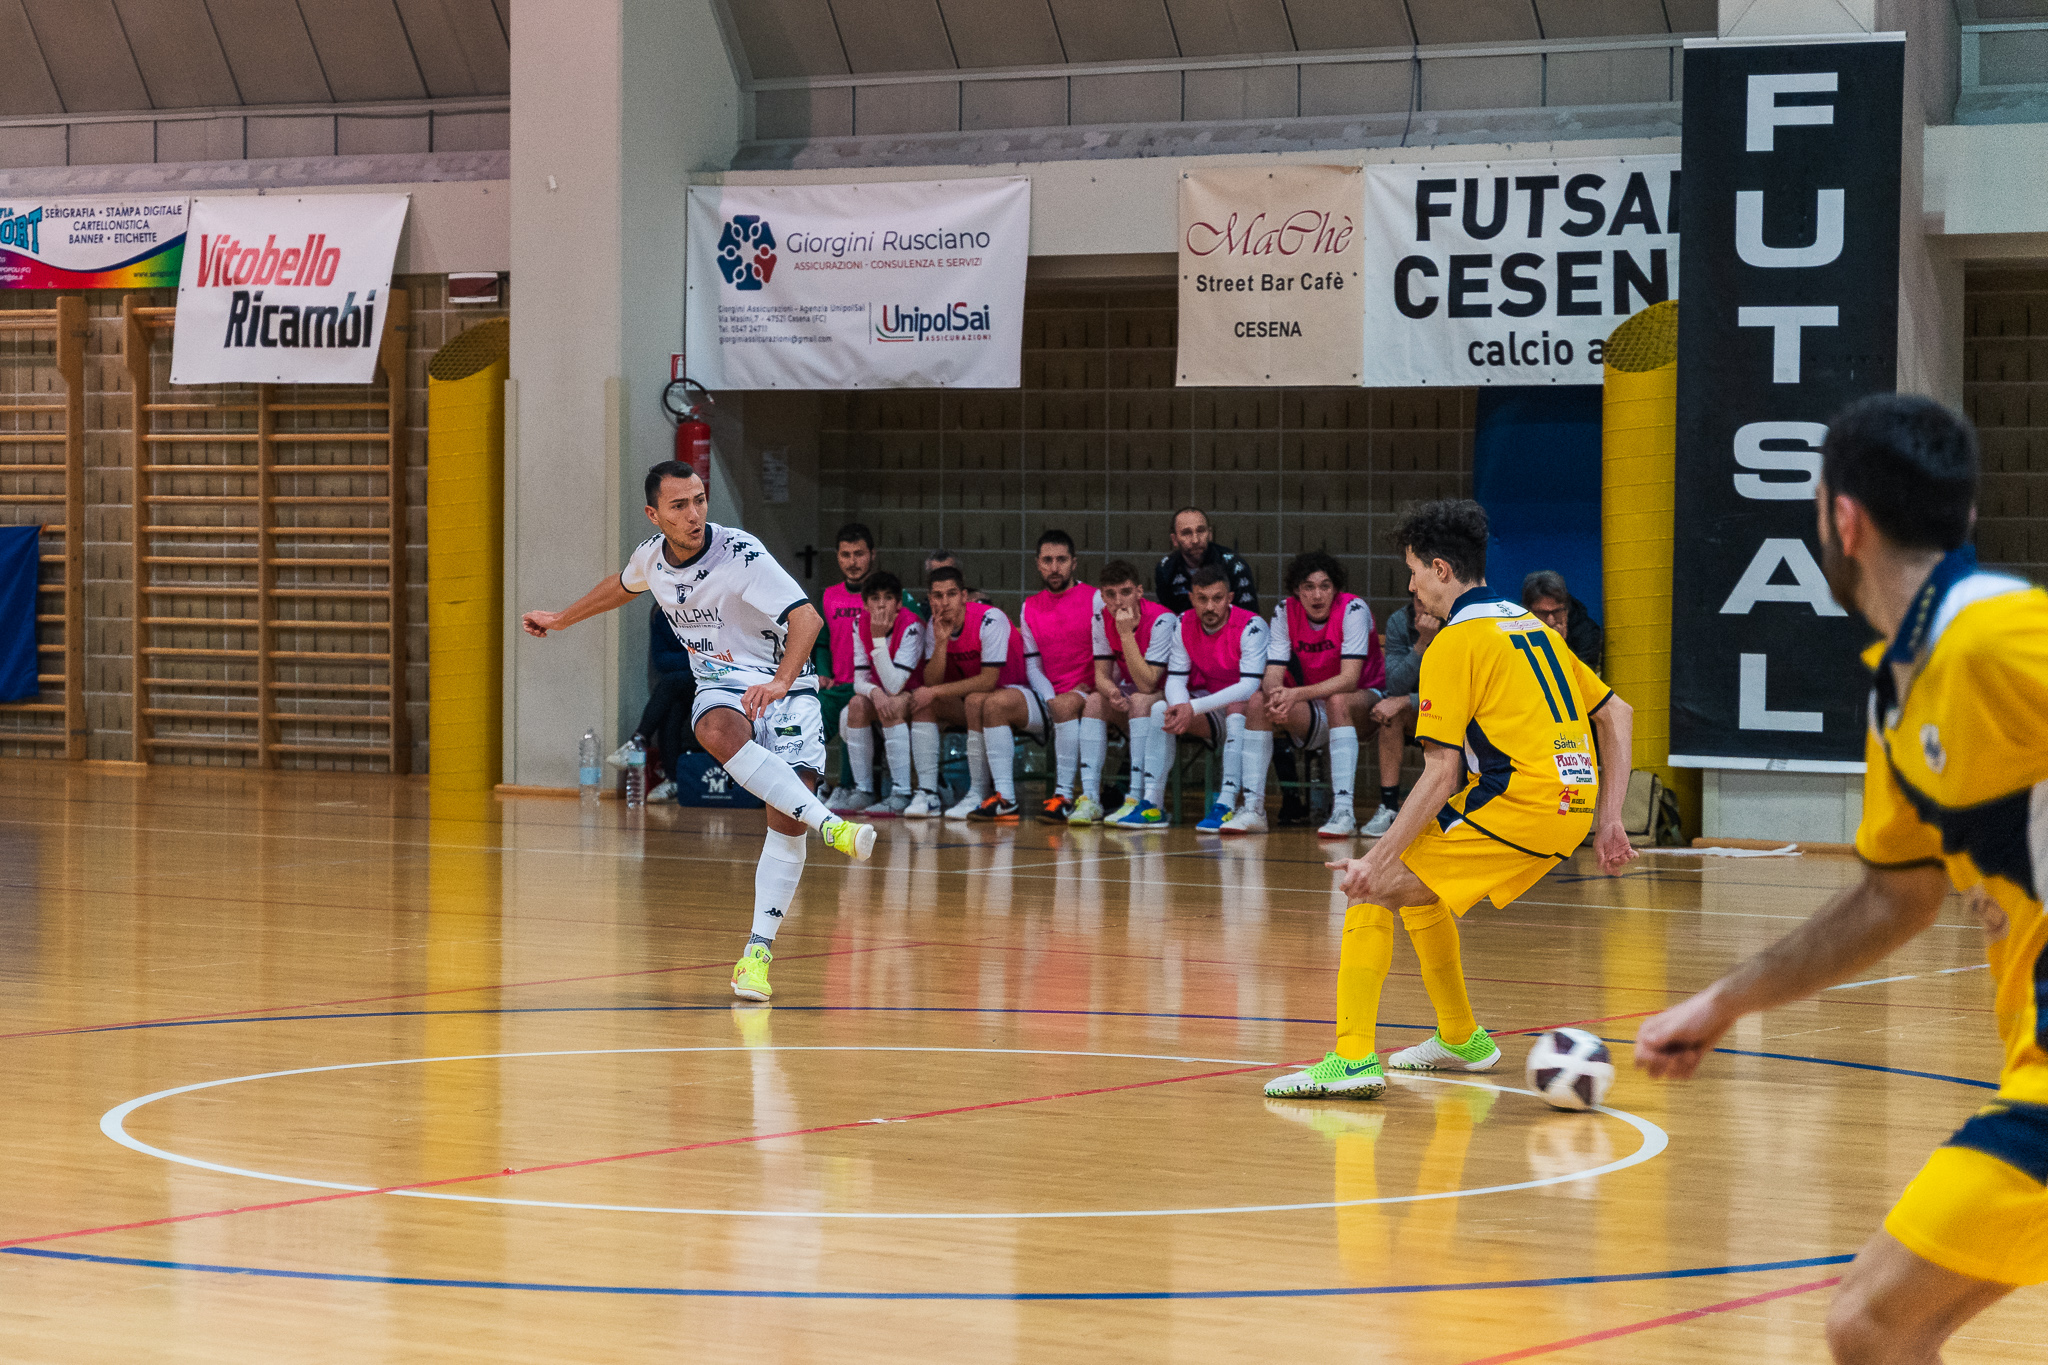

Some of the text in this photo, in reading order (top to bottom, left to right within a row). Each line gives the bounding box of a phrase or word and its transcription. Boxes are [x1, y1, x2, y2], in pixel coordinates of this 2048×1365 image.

[45, 205, 182, 219] SERIGRAFIA STAMPA DIGITALE
[73, 219, 150, 231] CARTELLONISTICA
[0, 205, 42, 255] ORT
[69, 232, 157, 244] BANNER ETICHETTE
[786, 228, 991, 258] Giorgini Rusciano
[197, 233, 341, 288] Vitobello
[794, 257, 983, 271] ASSICURAZIONI CONSULENZA E SERVIZI
[1195, 271, 1345, 293] Street Bar Cafè
[224, 290, 376, 348] Ricambi
[882, 301, 991, 342] UnipolSai
[1233, 320, 1303, 338] CESENA
[925, 333, 992, 343] ASSICURAZIONI
[1467, 330, 1574, 367] calcio
[1719, 72, 1849, 734] FUTSAL
[1508, 629, 1580, 724] 11
